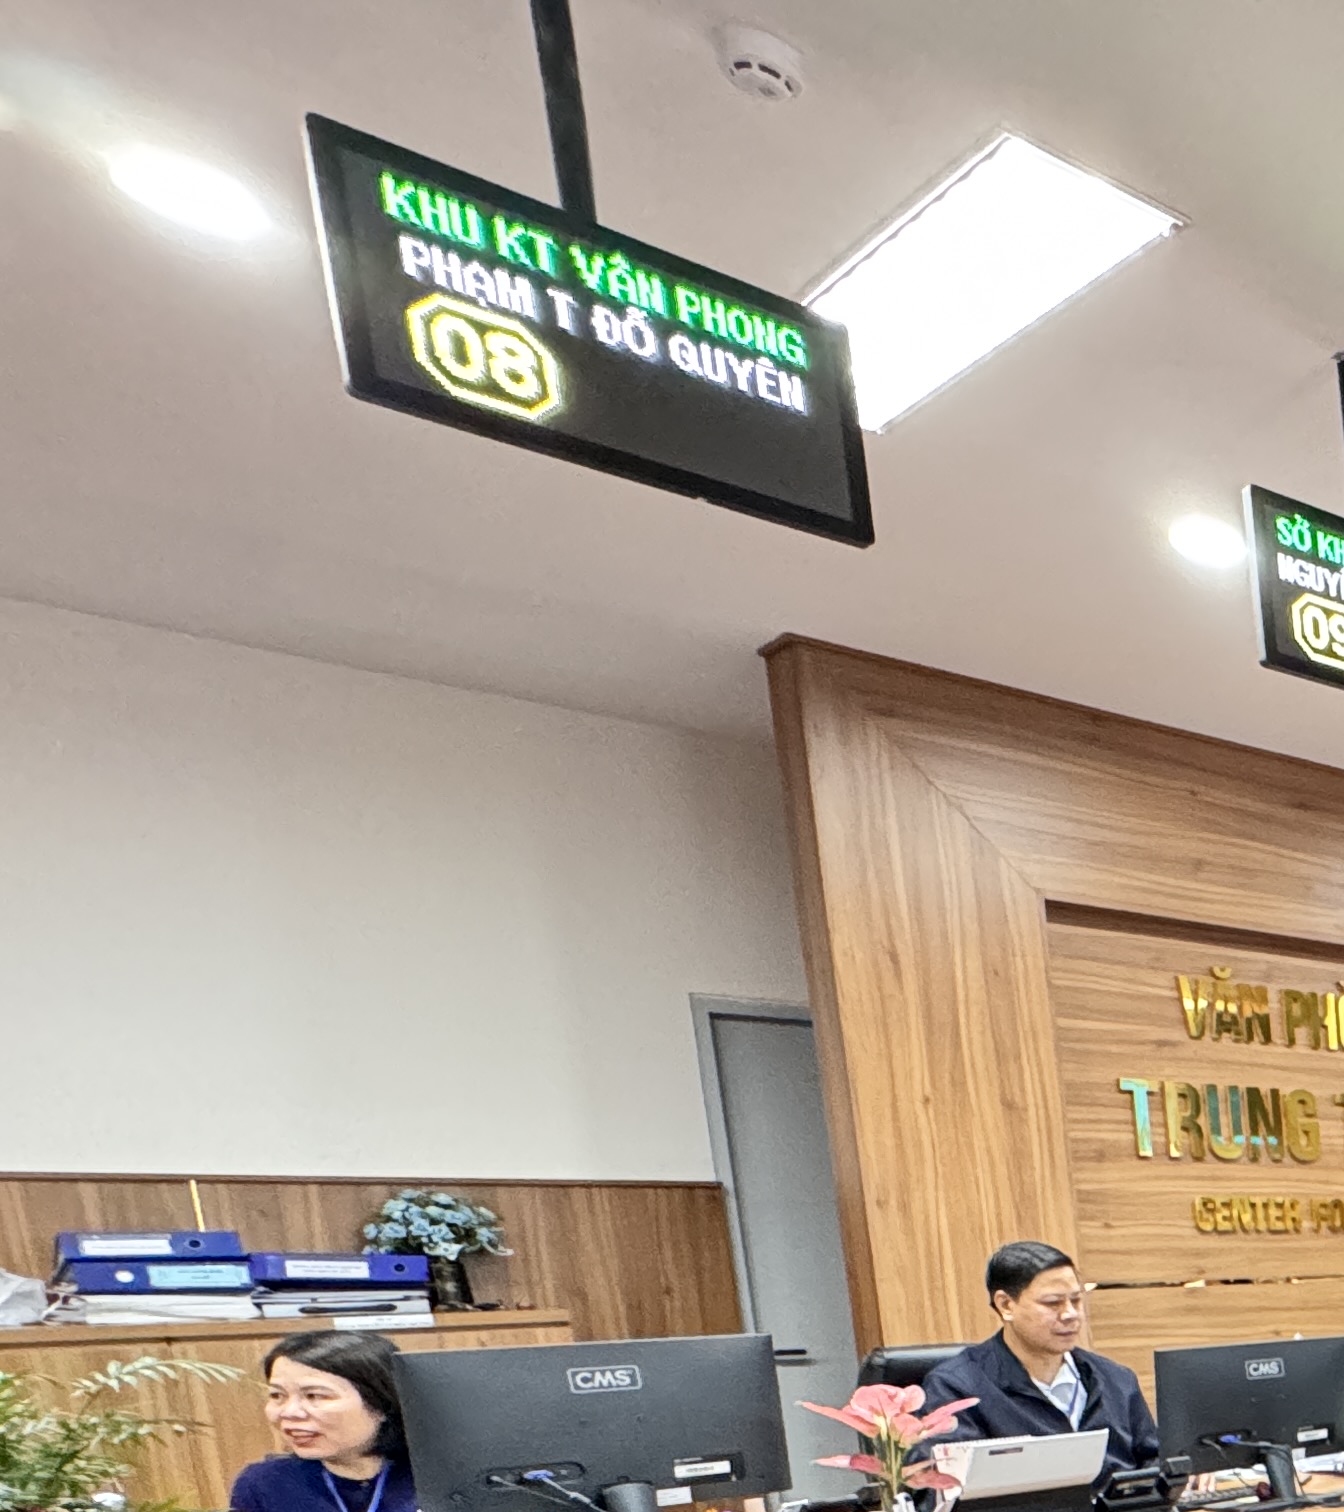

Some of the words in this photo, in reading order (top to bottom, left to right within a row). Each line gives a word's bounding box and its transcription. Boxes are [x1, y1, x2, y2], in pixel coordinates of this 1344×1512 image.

[379, 172, 484, 248] KHU
[492, 214, 560, 277] KT
[569, 243, 669, 320] VÂN
[675, 284, 809, 369] PHONG
[399, 235, 537, 319] PHẠM
[545, 288, 576, 331] T
[591, 303, 657, 361] ĐỖ
[668, 331, 809, 417] QUYÊN
[429, 312, 541, 399] 08
[1276, 514, 1311, 551] SỞ
[1176, 966, 1272, 1045] VĂN
[1118, 1077, 1321, 1163] TRUNG
[1192, 1196, 1302, 1234] CENTER
[575, 1369, 631, 1389] CMS
[1249, 1361, 1279, 1376] CMS
